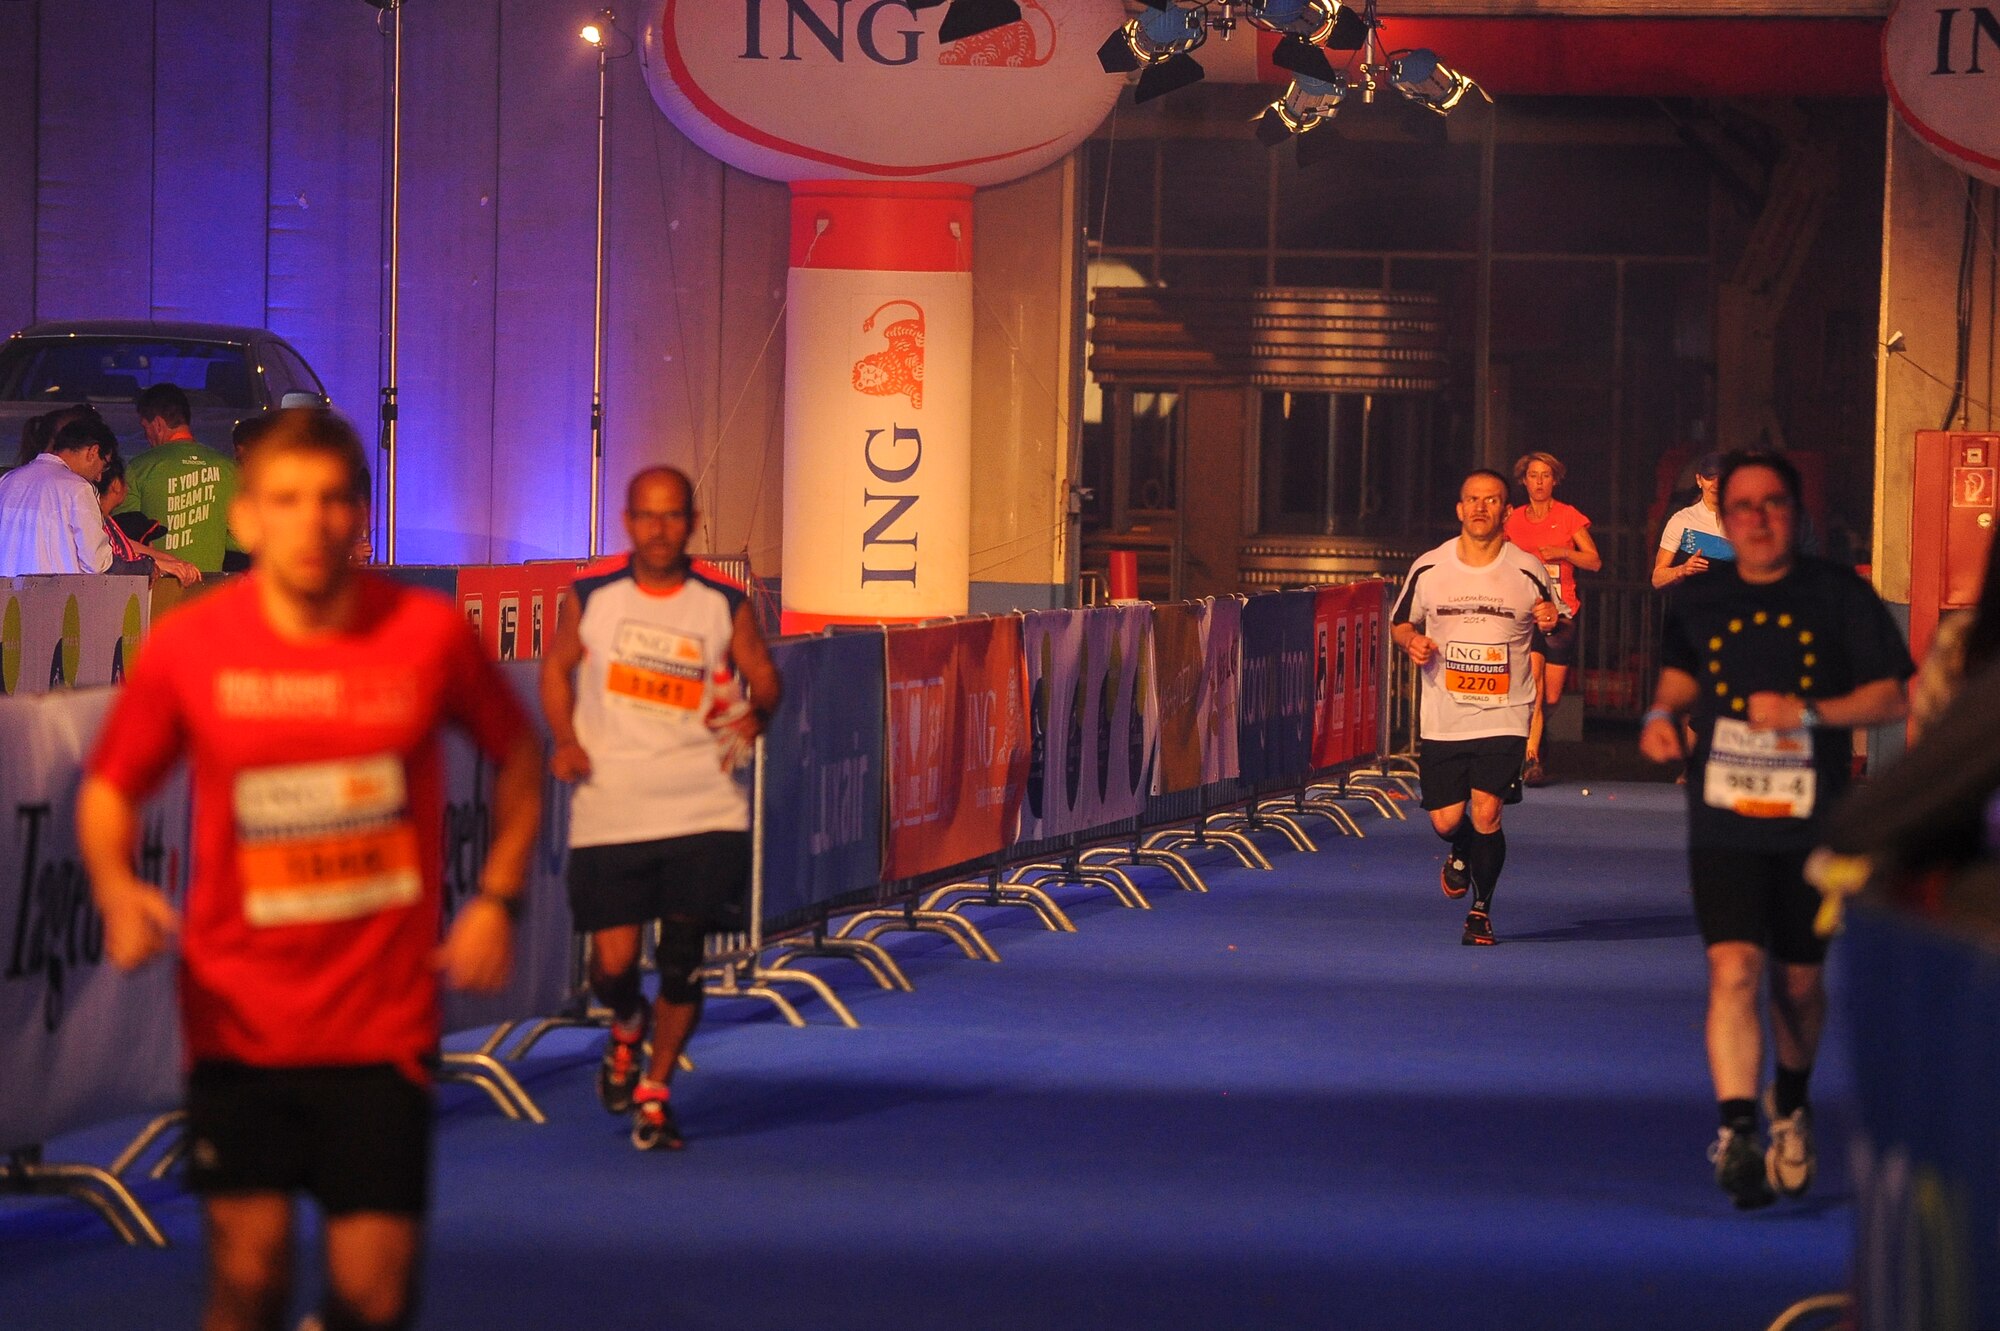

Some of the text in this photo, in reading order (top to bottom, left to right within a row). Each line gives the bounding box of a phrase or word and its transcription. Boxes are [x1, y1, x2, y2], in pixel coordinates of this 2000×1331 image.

[738, 0, 925, 66] ING
[168, 466, 220, 494] IF YOU CAN
[167, 485, 216, 512] DREAM IT,
[861, 422, 922, 589] ING
[167, 503, 210, 531] YOU CAN
[165, 528, 194, 550] DO IT.
[1463, 616, 1487, 624] 2014
[1450, 646, 1481, 660] ING
[1446, 662, 1505, 673] LUXEMBOURG
[1457, 675, 1497, 691] 2270
[1462, 694, 1490, 702] DONALD
[966, 690, 997, 772] ING
